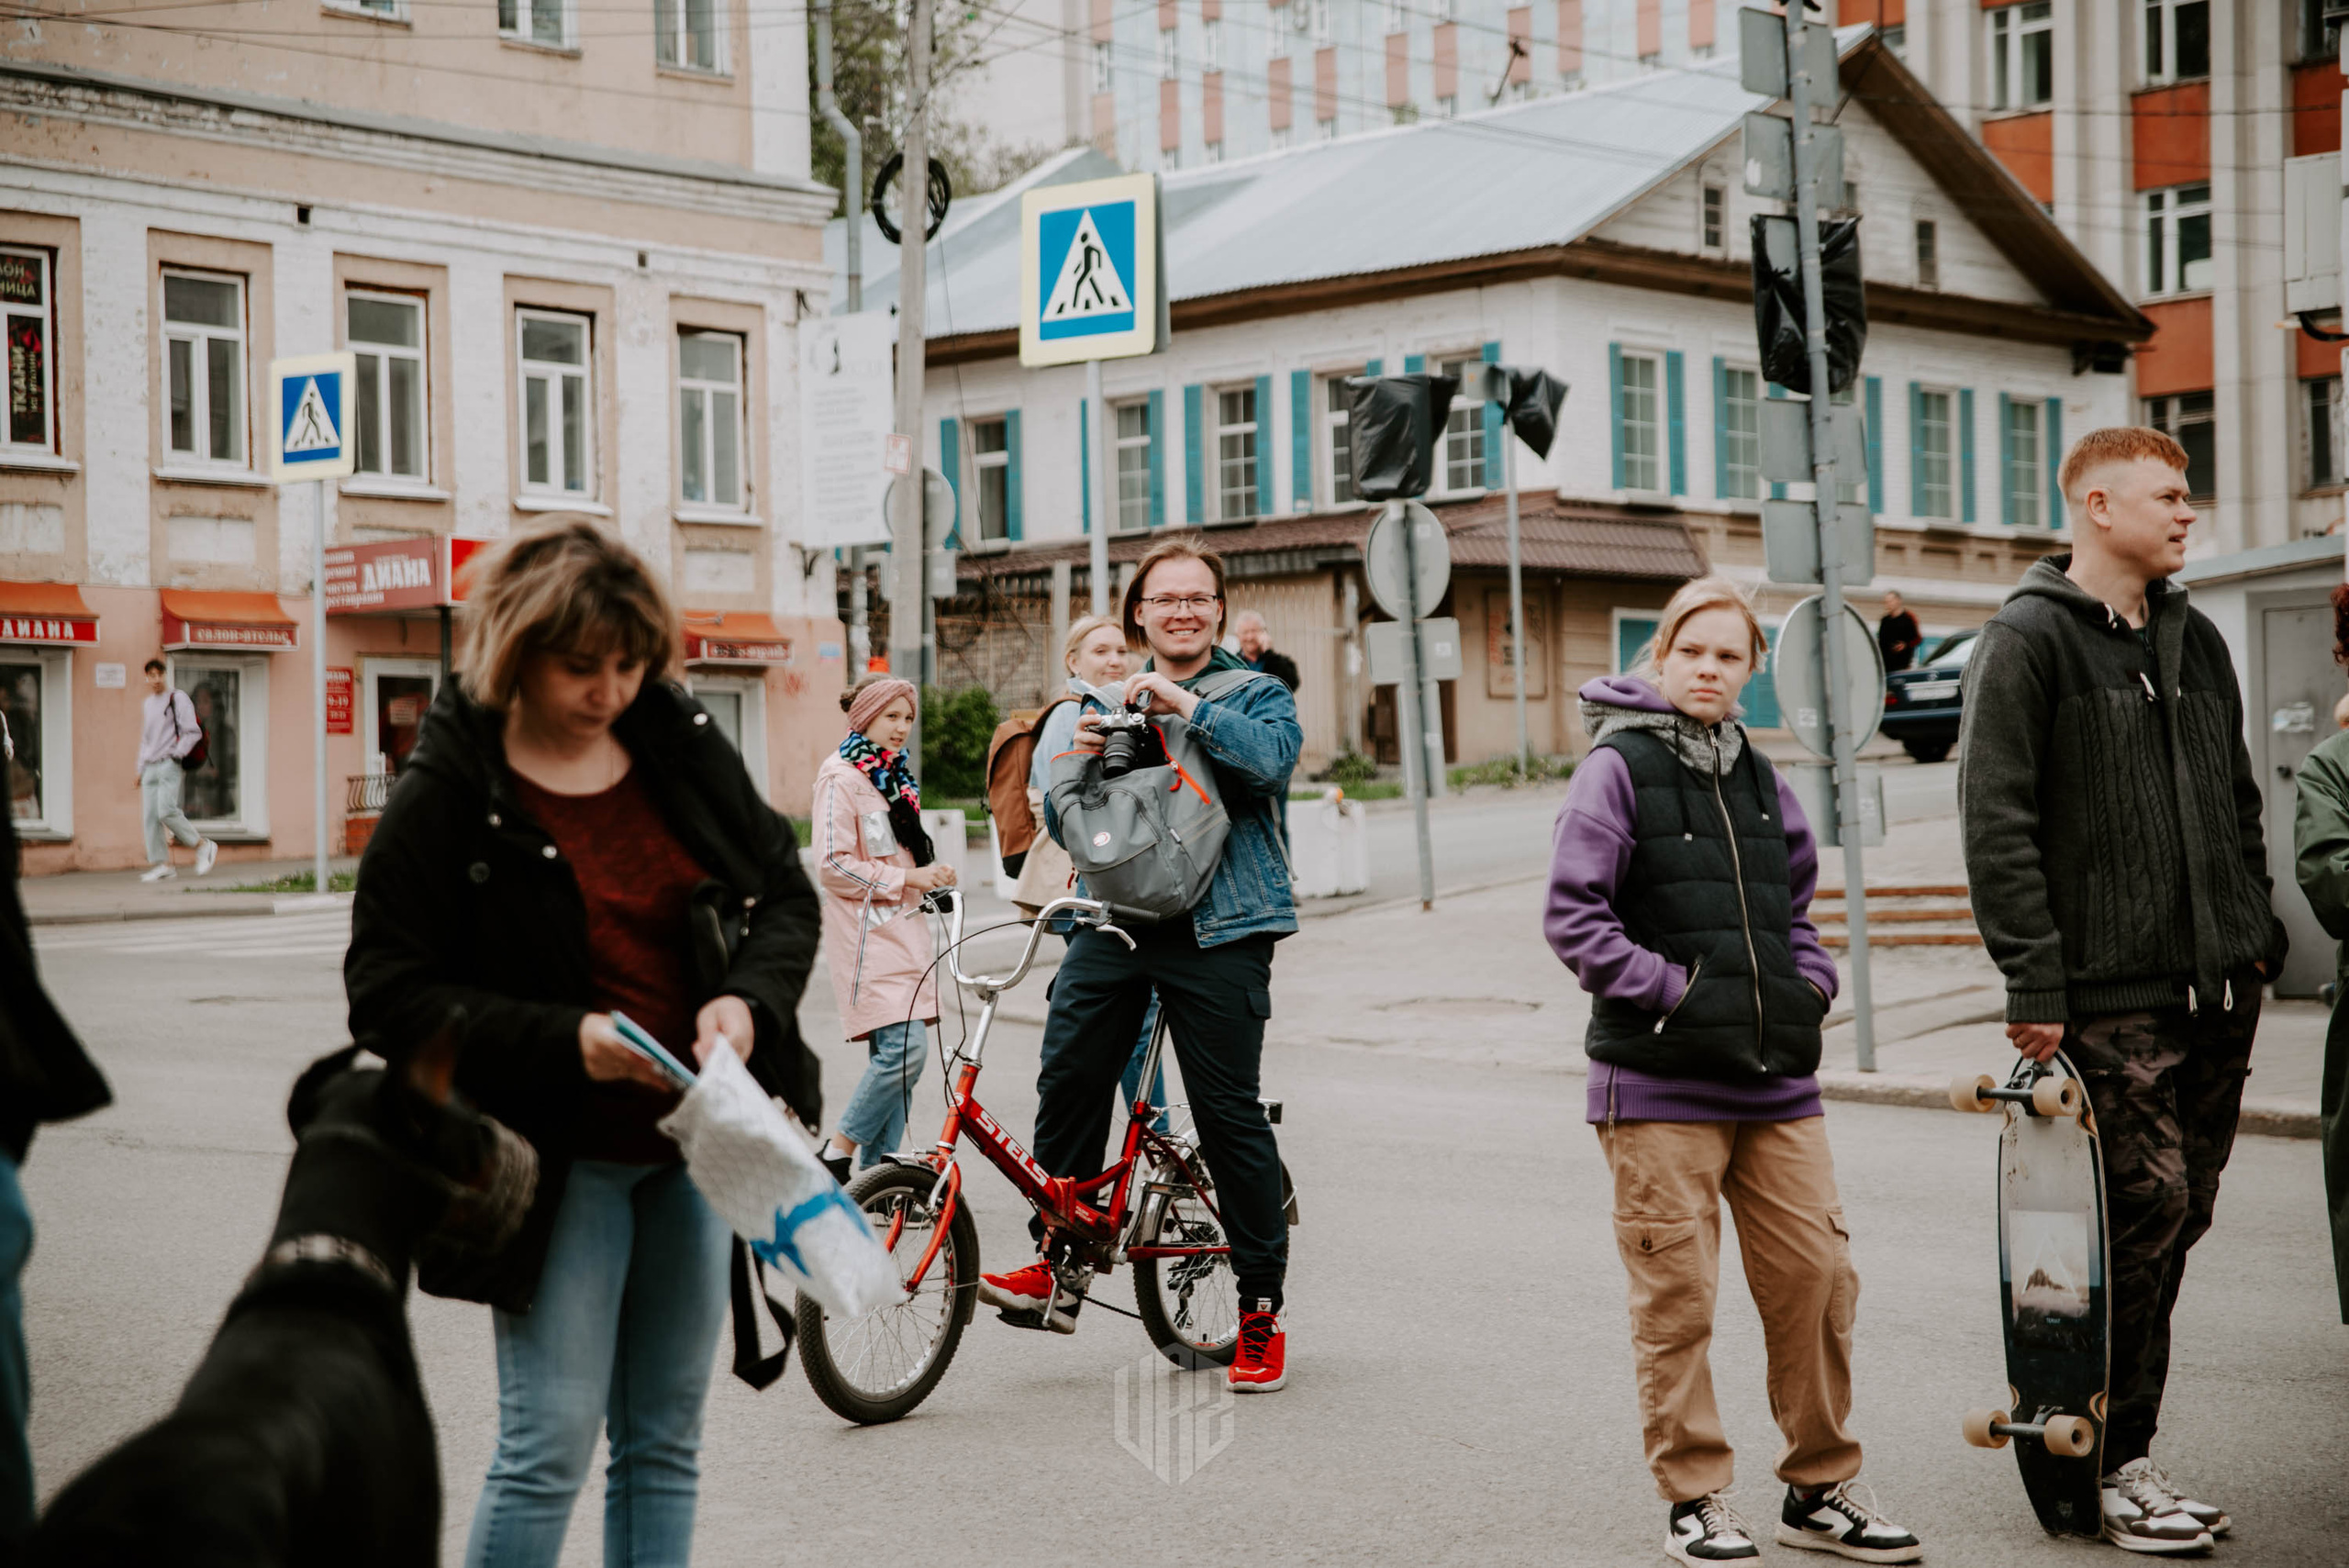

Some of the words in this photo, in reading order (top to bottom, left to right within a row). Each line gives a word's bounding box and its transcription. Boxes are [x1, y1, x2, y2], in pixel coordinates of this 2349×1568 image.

[362, 557, 431, 591] ДИАНА
[2, 618, 74, 639] ДИАНА
[326, 671, 351, 683] ИАНА
[975, 1110, 1050, 1187] STELS
